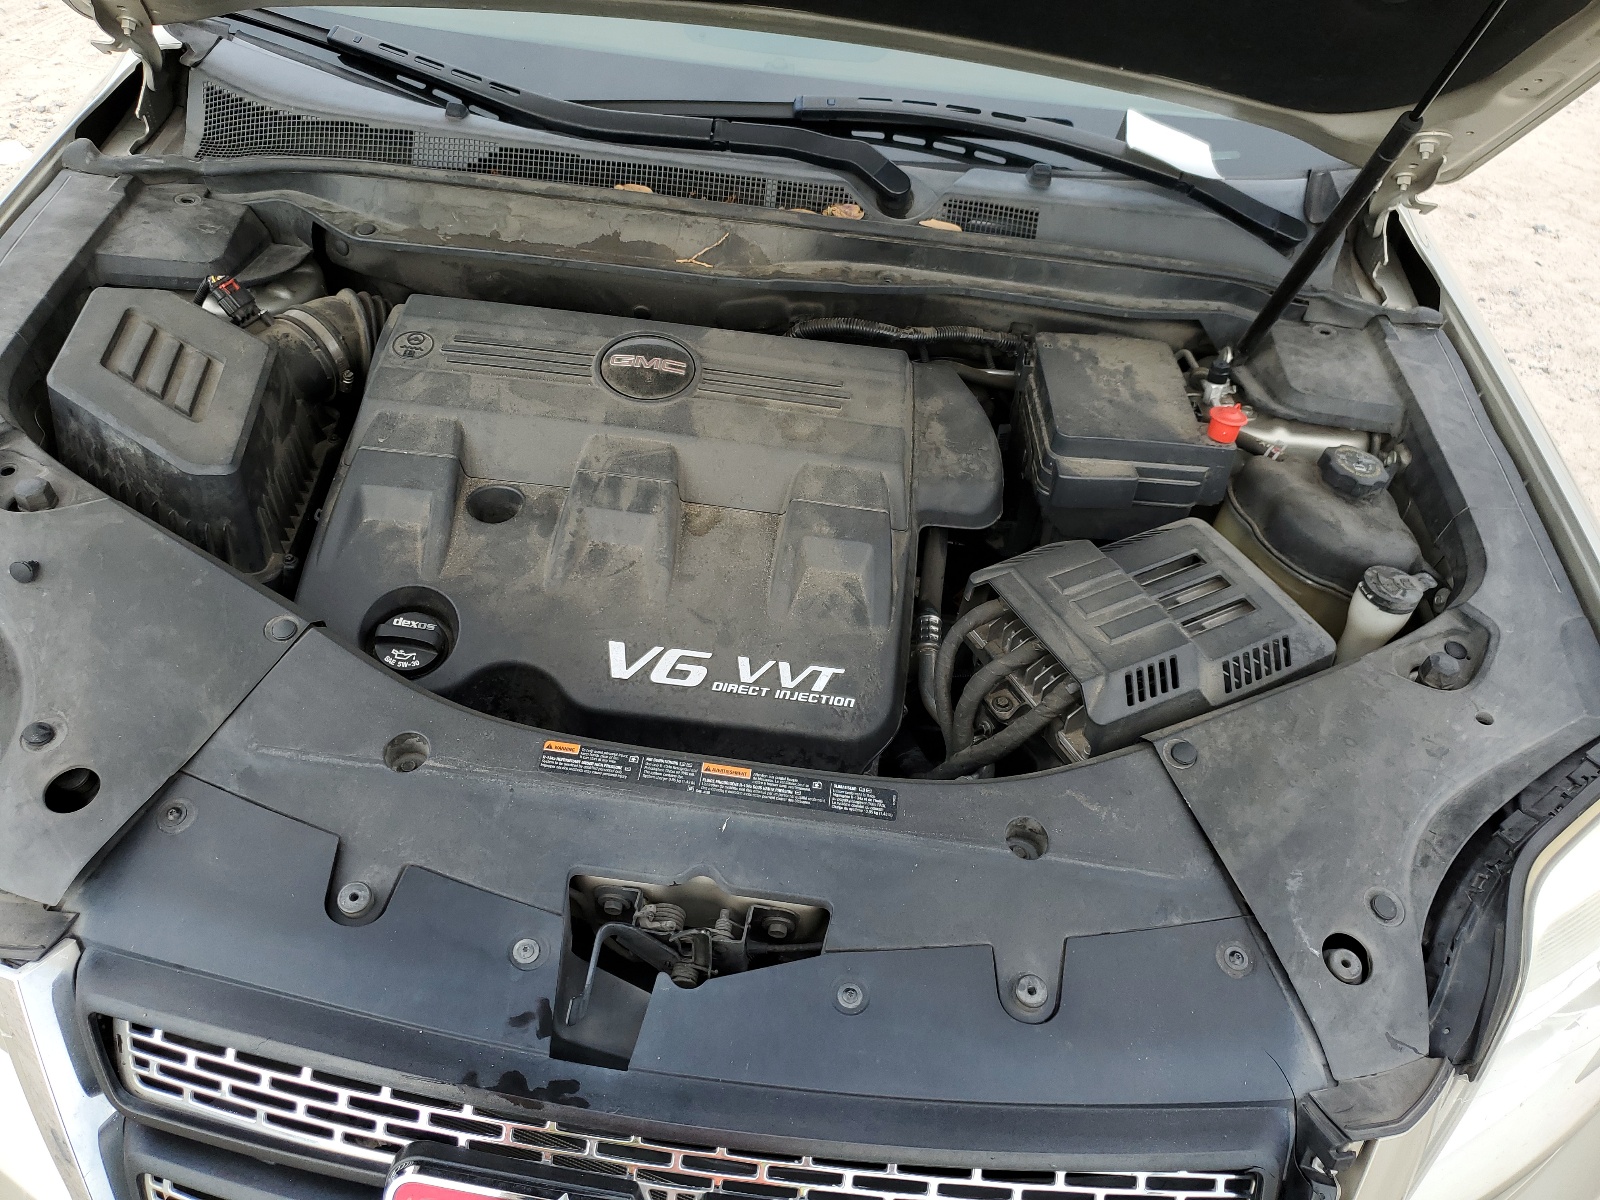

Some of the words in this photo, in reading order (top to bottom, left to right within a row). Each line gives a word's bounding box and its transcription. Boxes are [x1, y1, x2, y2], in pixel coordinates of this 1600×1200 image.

[610, 354, 687, 376] GMC
[393, 618, 437, 631] dexos
[397, 660, 420, 668] 5W-30
[608, 640, 713, 687] V6
[737, 656, 845, 692] VVT
[711, 681, 771, 697] DIRECT
[774, 689, 856, 708] INJECTION
